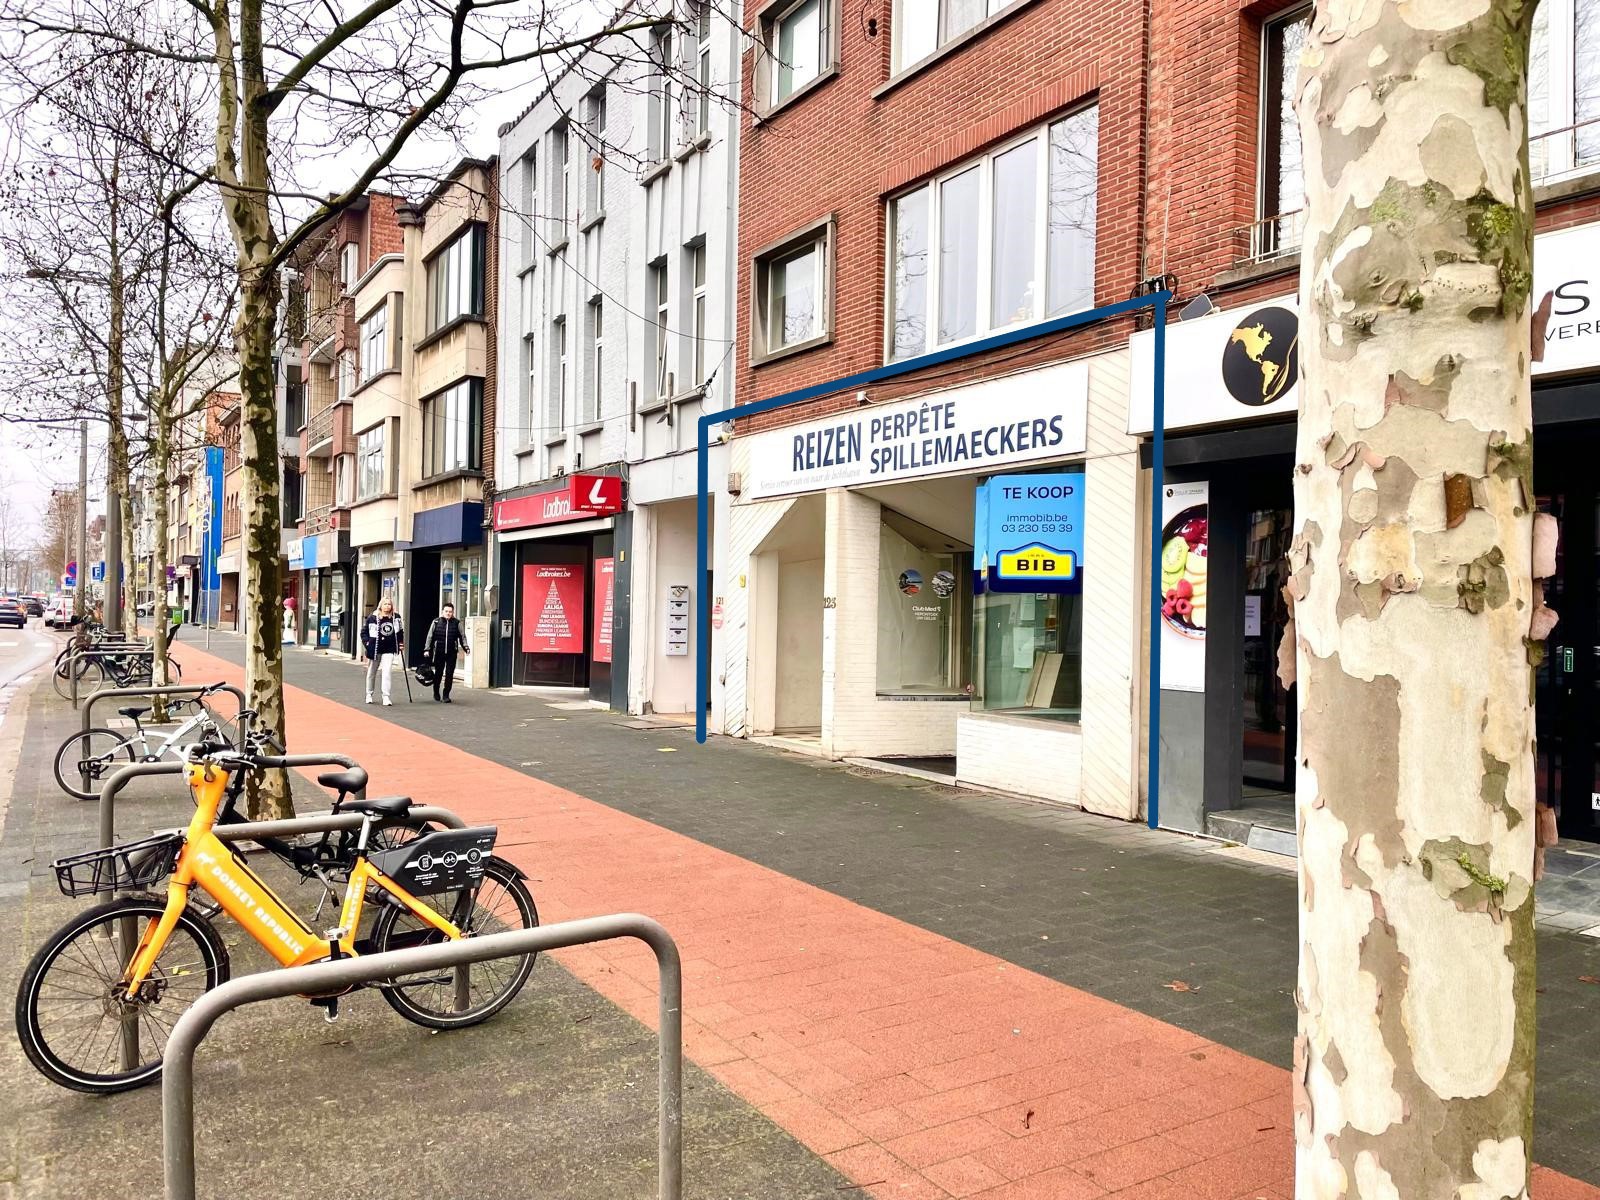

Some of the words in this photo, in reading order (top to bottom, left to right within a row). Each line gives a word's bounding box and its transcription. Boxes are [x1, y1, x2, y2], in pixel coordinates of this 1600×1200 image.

[870, 401, 956, 444] PERPÊTE
[792, 422, 862, 472] REIZEN
[869, 414, 1064, 474] SPILLEMAECKERS
[1002, 487, 1022, 499] TE
[1027, 486, 1074, 499] KOOP
[1001, 524, 1016, 533] 03
[1018, 524, 1039, 533] 230
[1041, 524, 1056, 533] 59
[1058, 524, 1073, 533] 39
[1006, 513, 1068, 522] immobib.be
[1016, 559, 1056, 572] BIB
[211, 866, 256, 909] DONKEY
[254, 907, 305, 956] REPUBLIC
